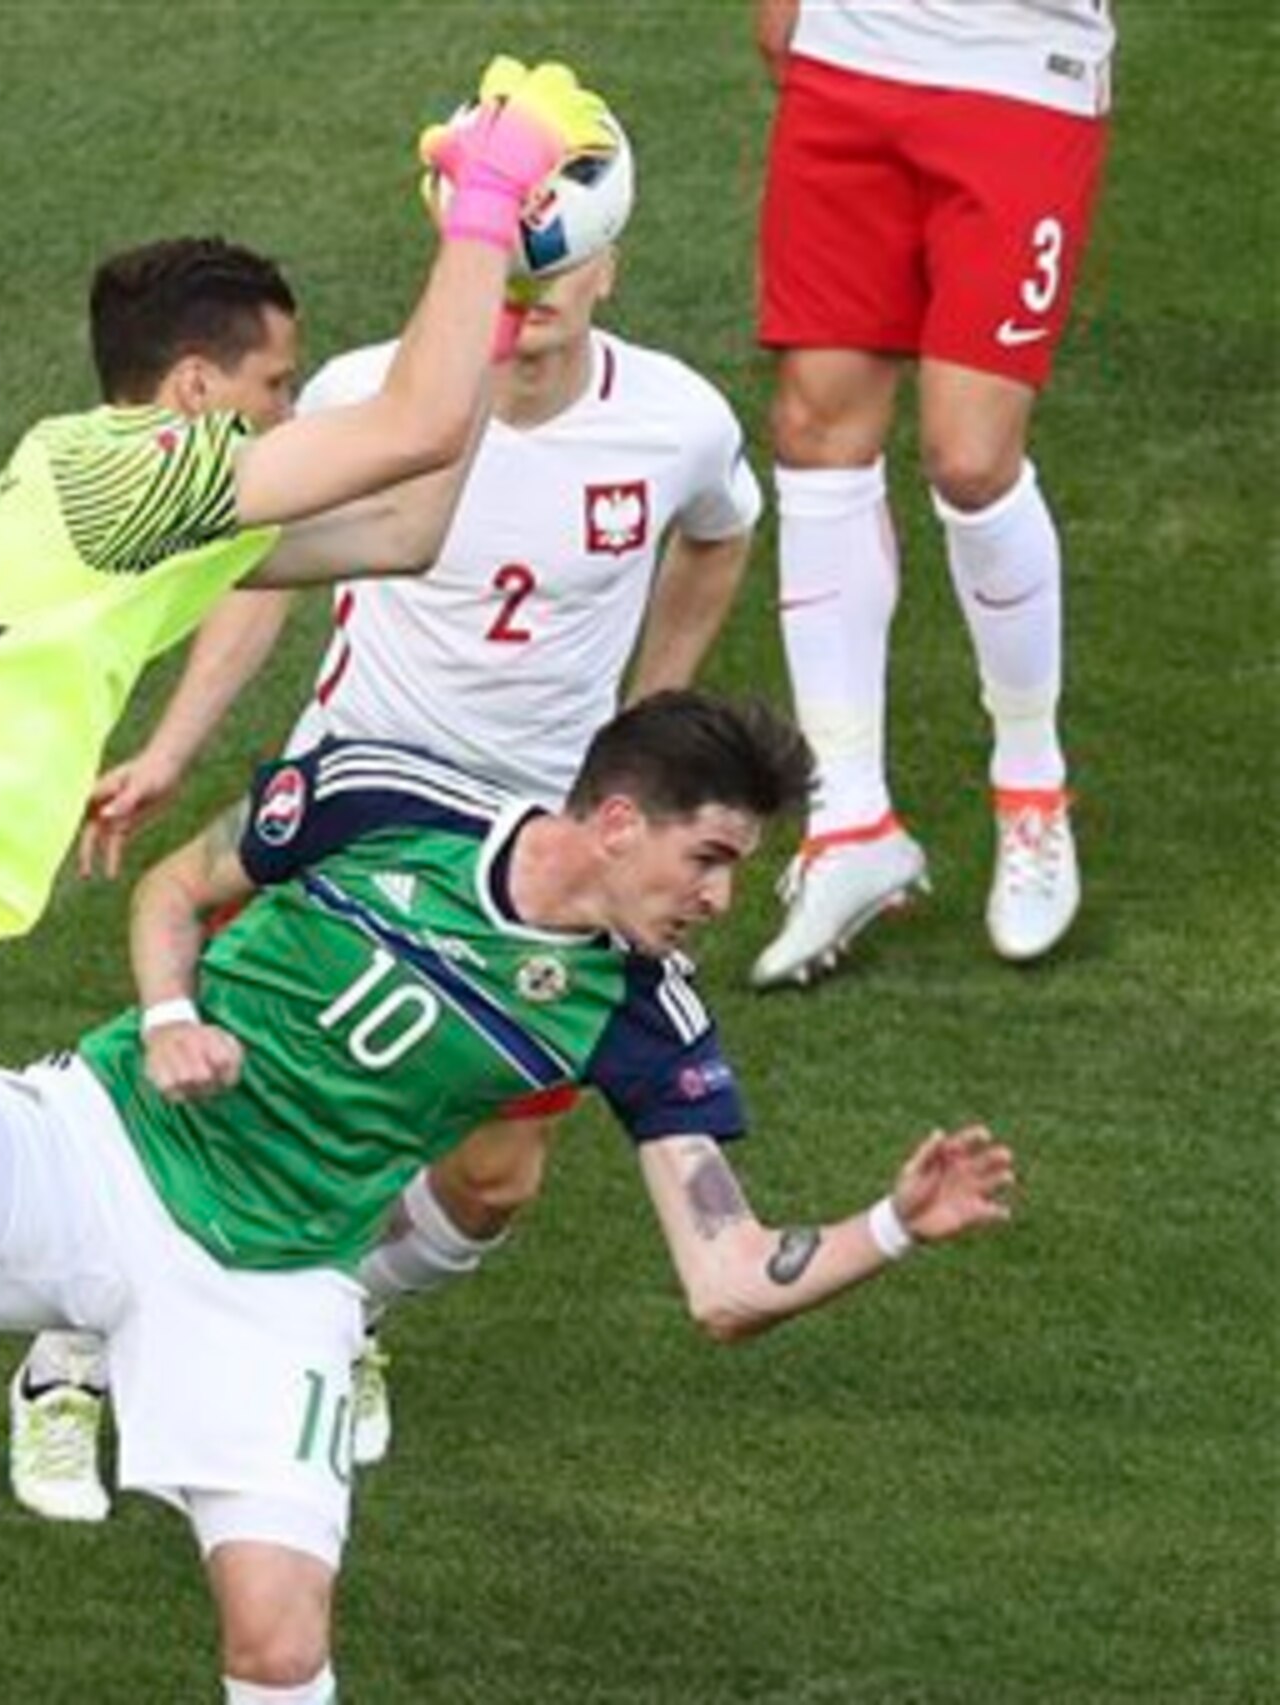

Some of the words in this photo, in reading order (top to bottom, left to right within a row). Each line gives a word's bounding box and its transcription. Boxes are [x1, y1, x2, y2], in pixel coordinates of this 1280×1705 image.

[1021, 217, 1063, 313] 3
[486, 563, 535, 643] 2
[317, 947, 439, 1070] 10
